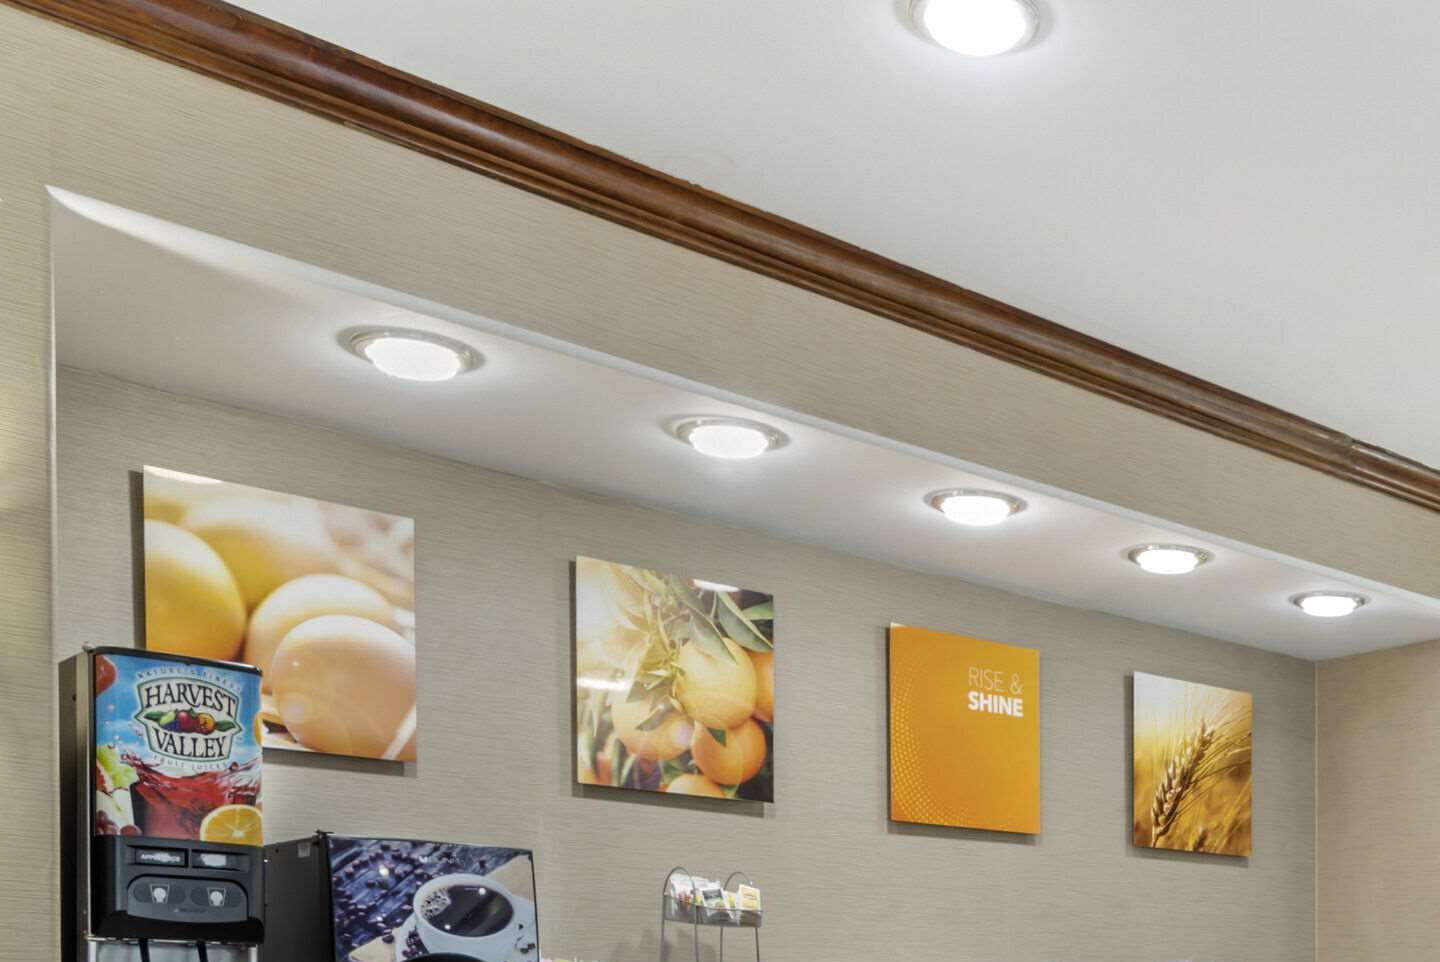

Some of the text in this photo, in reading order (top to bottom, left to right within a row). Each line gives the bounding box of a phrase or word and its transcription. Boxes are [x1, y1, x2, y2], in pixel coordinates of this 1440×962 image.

[968, 666, 1024, 695] RISE &
[144, 683, 236, 717] HARVEST
[967, 690, 1024, 718] SHINE
[152, 728, 227, 758] VALLEY
